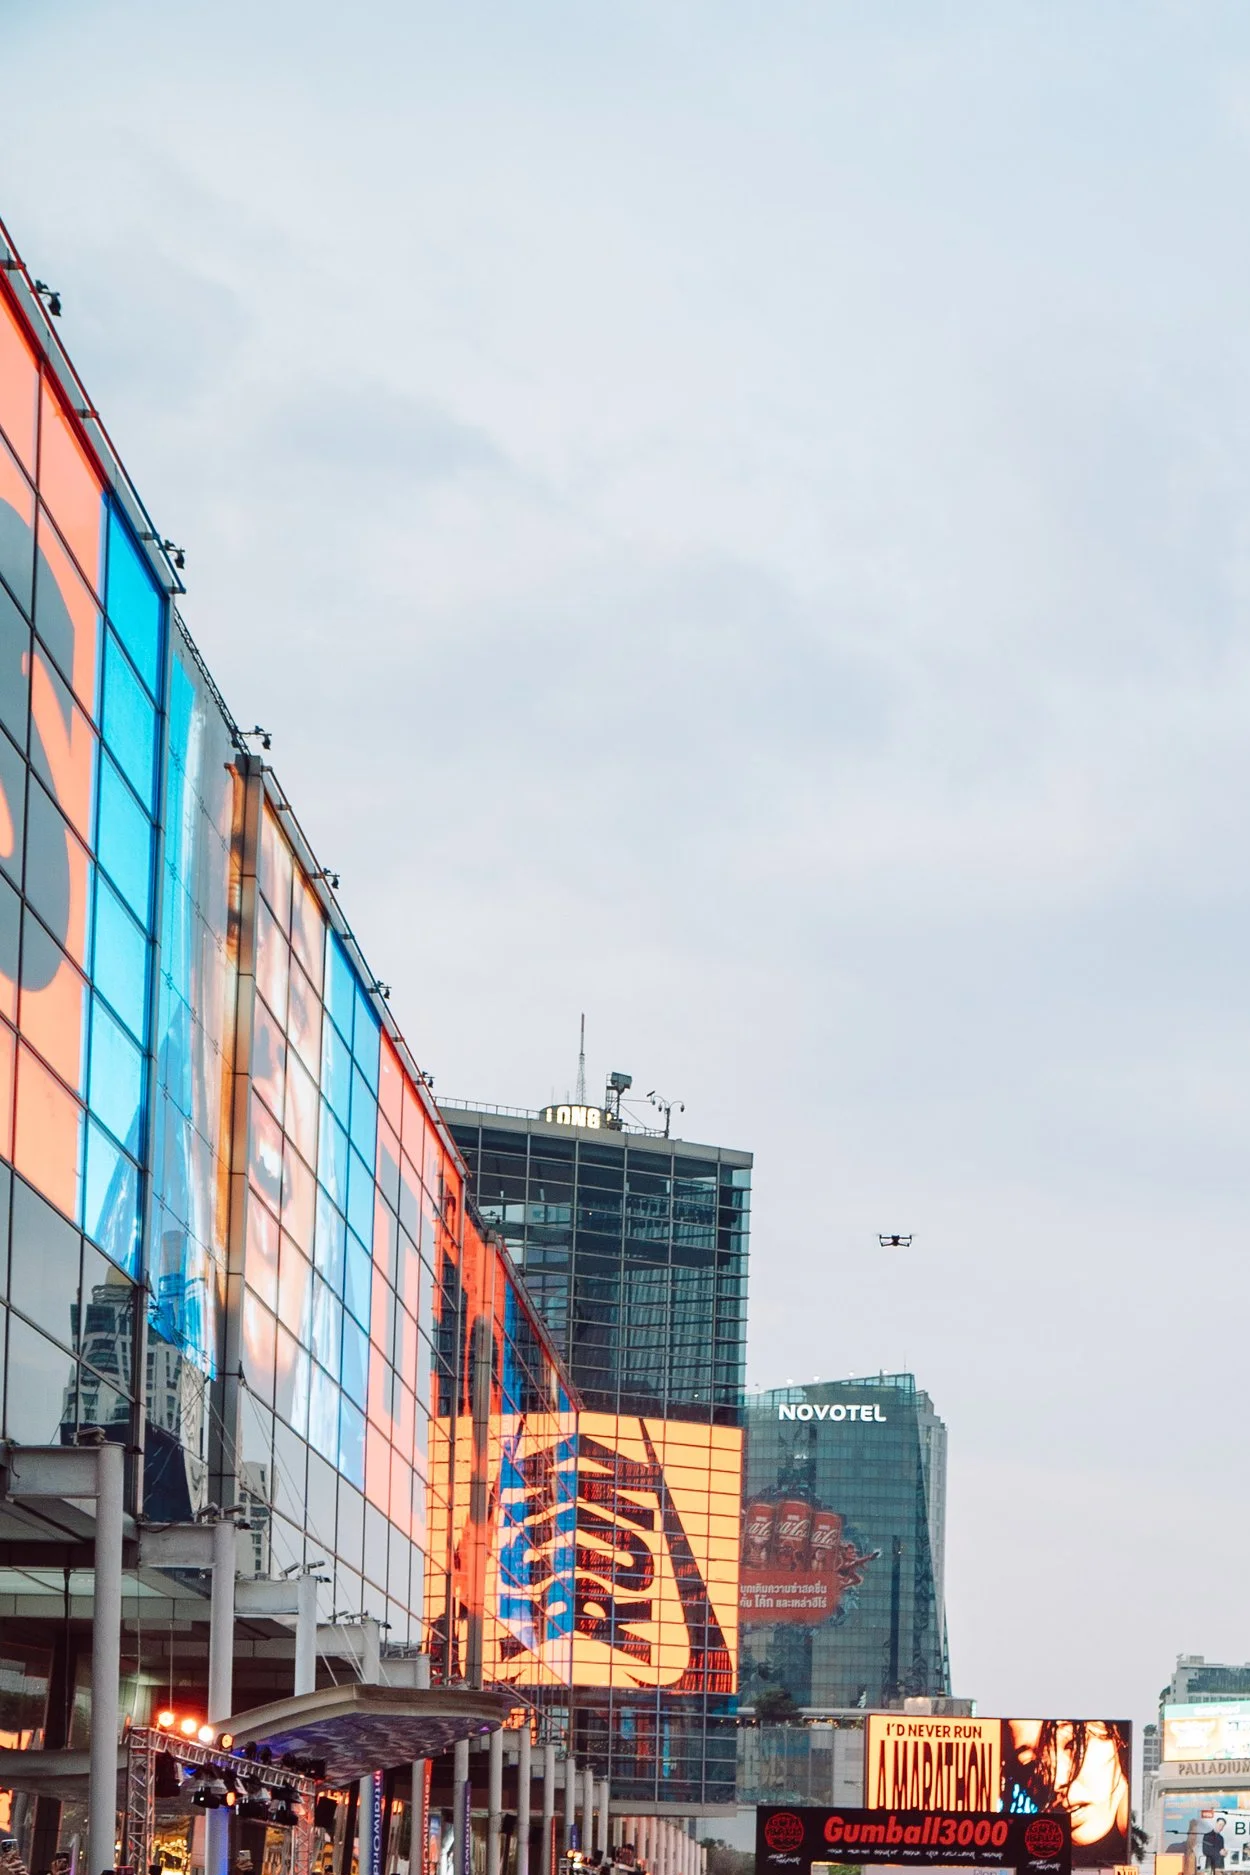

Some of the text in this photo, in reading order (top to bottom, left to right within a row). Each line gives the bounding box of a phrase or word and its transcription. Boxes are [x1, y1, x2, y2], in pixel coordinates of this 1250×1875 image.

[778, 1404, 887, 1422] NOVOTEL
[886, 1723, 982, 1739] I'D NEVER RUN
[893, 1740, 993, 1812] MARATHON
[823, 1815, 1009, 1847] Gumball3000
